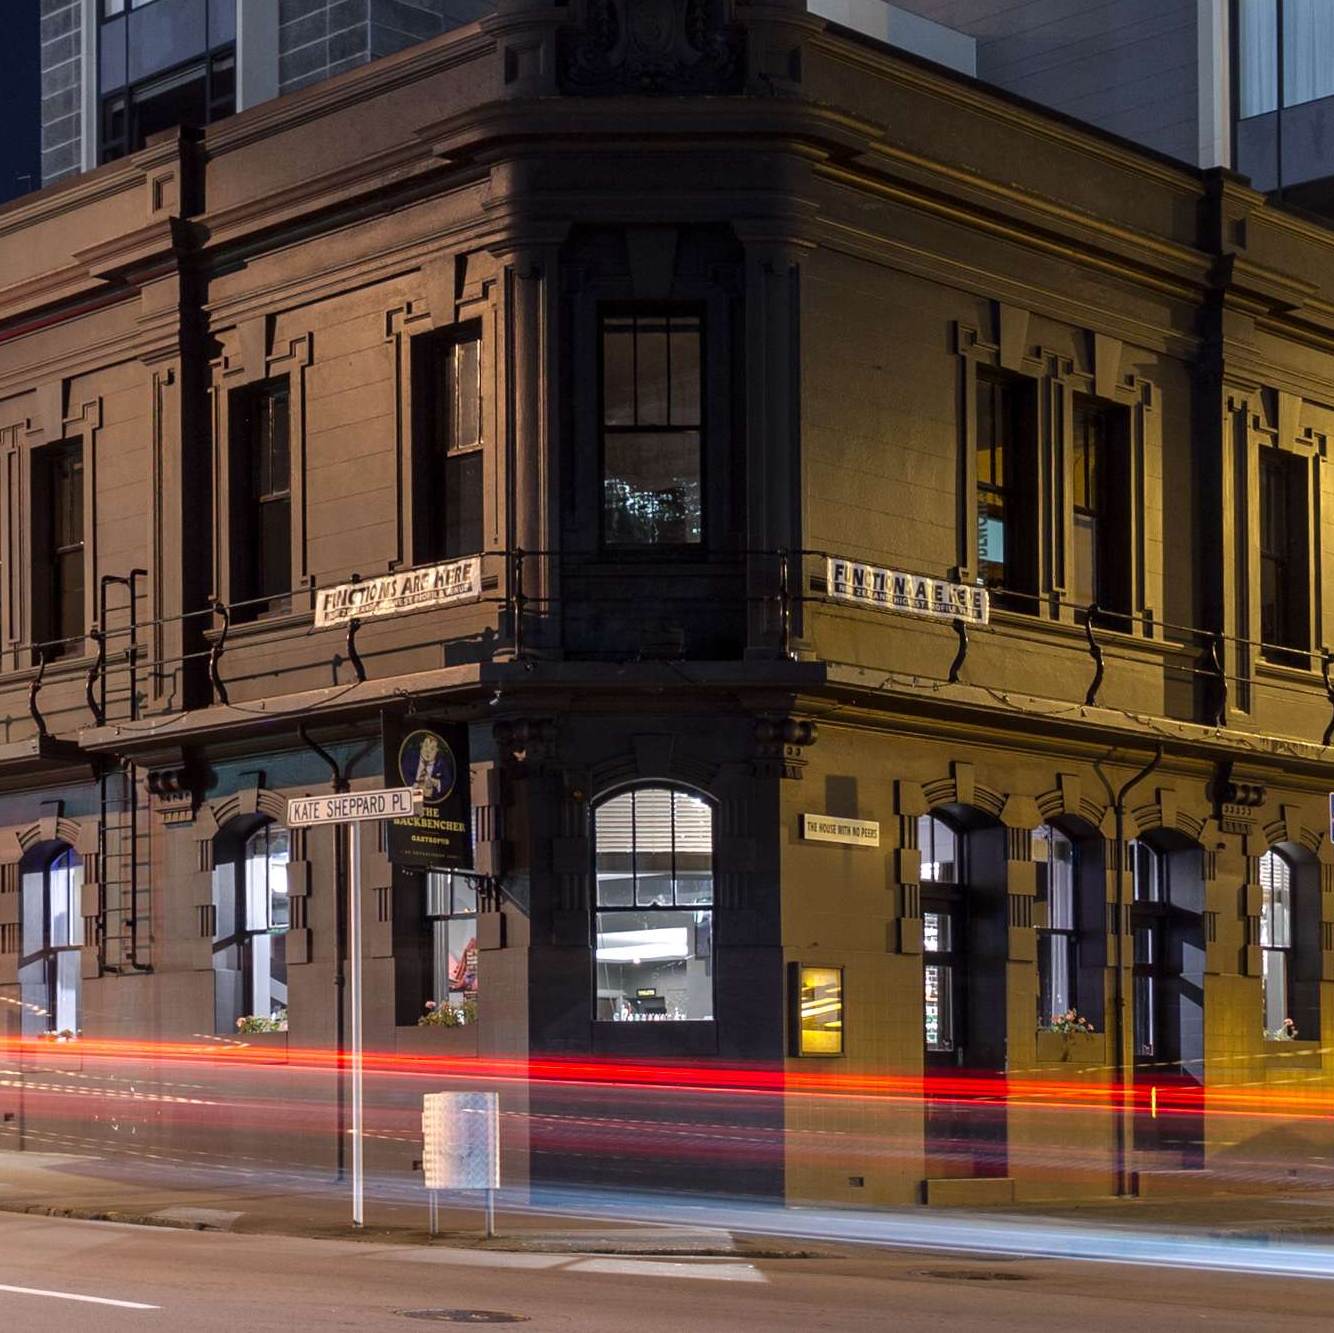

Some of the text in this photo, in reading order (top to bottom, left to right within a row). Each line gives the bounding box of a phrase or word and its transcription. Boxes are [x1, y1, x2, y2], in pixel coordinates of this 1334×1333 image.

[433, 562, 473, 589] HERE
[293, 792, 407, 821] KATE SHEPPARD PL
[423, 807, 440, 818] THE
[393, 817, 466, 833] BACKBENCHER
[807, 821, 878, 839] THE HOUSE WITH NO PEERS
